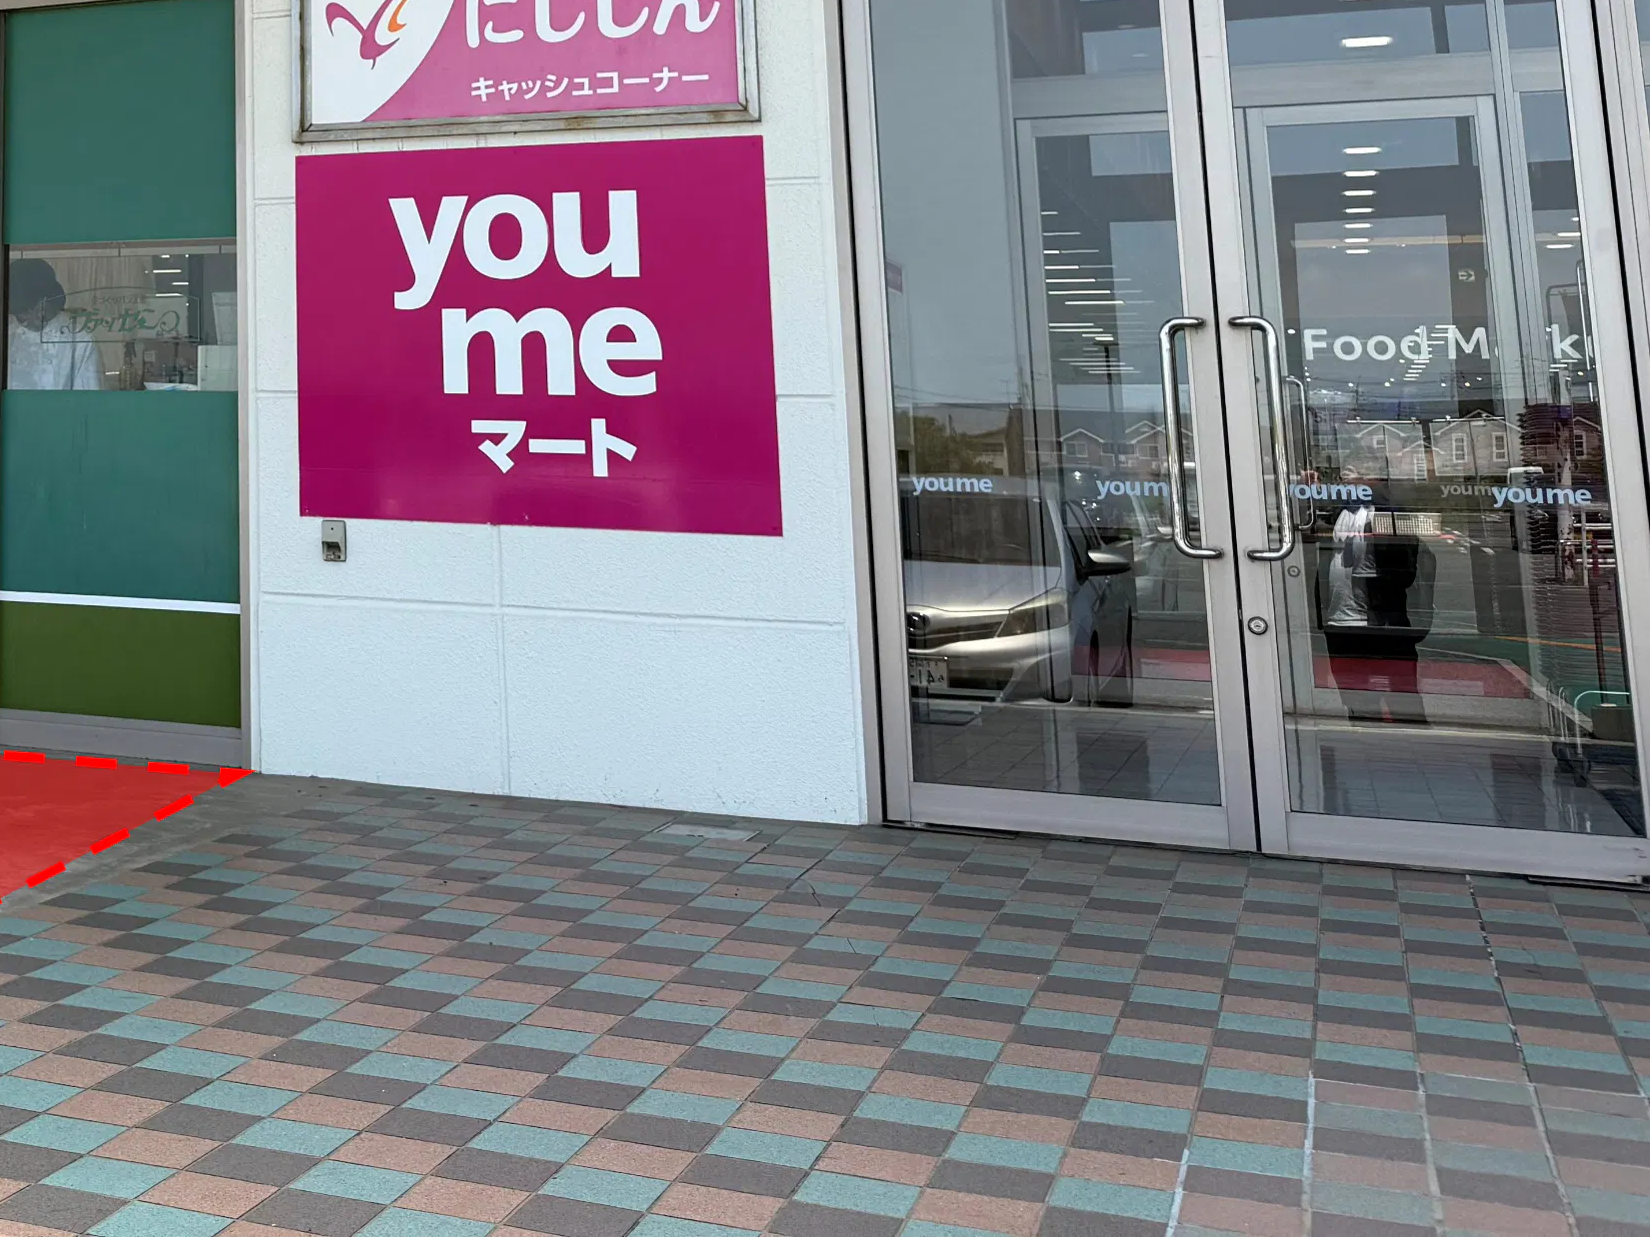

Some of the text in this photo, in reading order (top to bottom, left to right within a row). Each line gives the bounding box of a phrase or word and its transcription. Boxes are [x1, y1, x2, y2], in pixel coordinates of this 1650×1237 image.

[471, 66, 709, 102] キャッシュコーナー
[388, 190, 640, 311] you
[441, 307, 663, 396] me
[1303, 325, 1432, 361] Food
[471, 418, 638, 478] マート
[1096, 480, 1169, 500] youm
